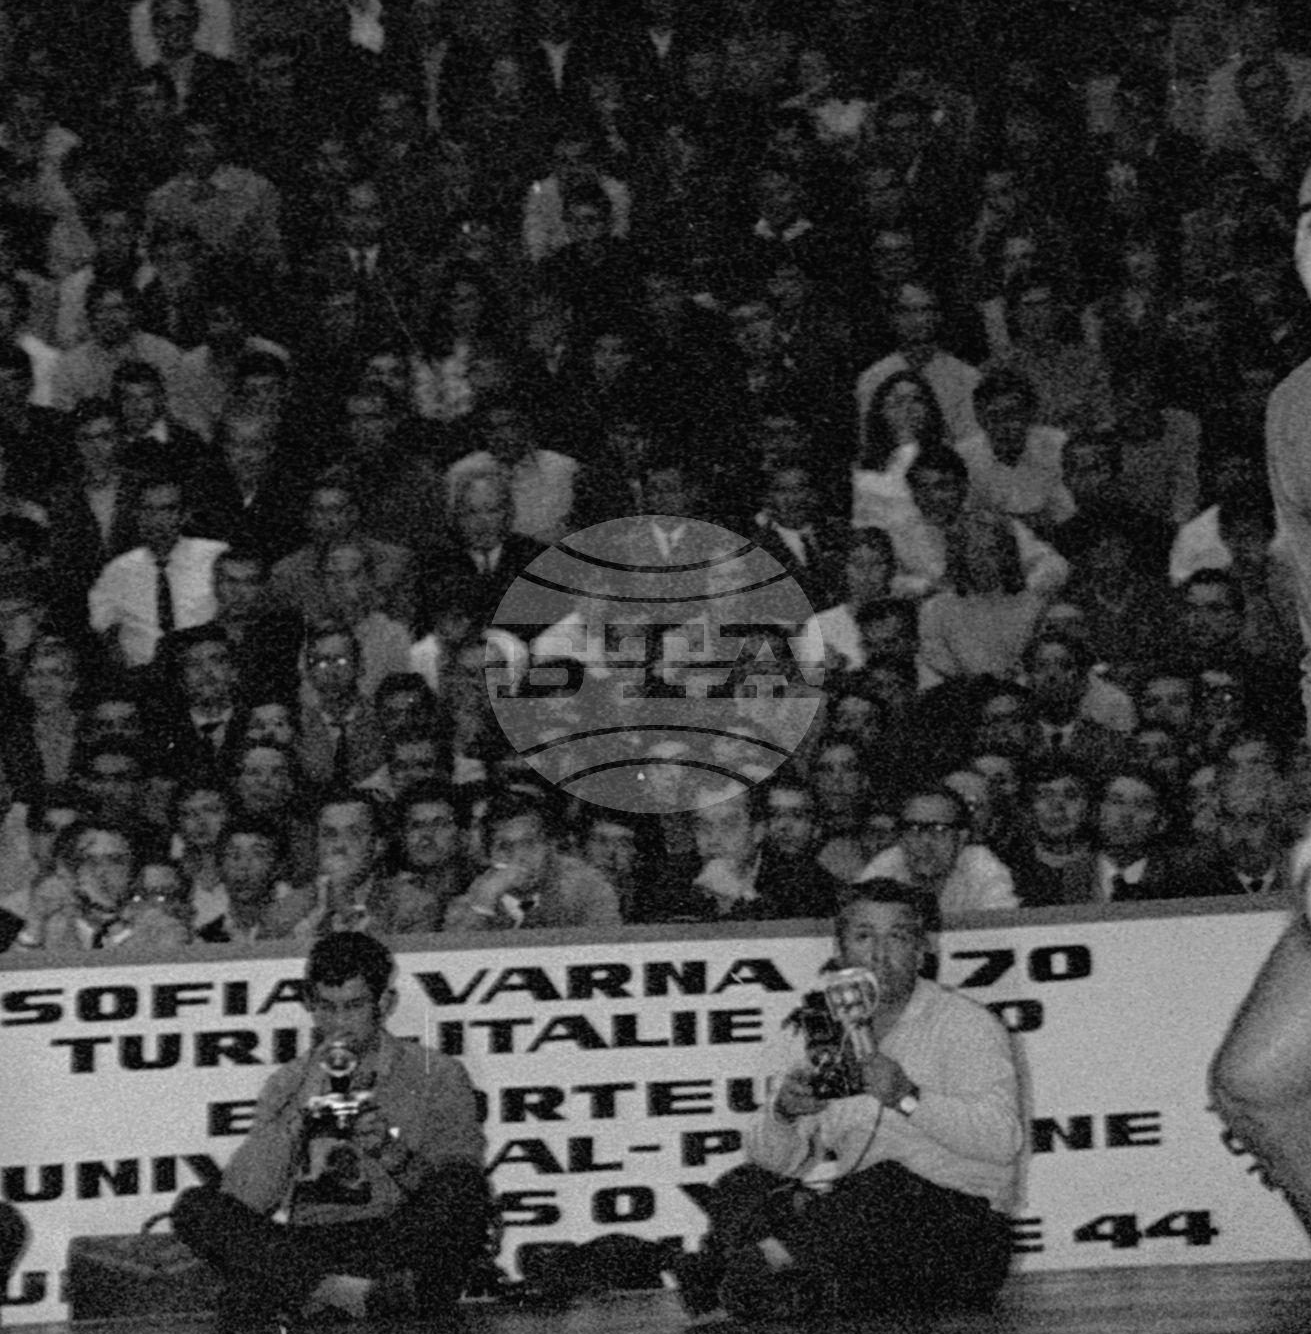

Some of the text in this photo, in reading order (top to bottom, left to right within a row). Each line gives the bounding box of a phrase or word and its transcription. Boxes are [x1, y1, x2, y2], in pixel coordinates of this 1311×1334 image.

[0, 979, 318, 1027] SOFIA
[412, 958, 794, 1007] VARNA
[50, 1008, 763, 1074] TURI ITALIE
[1073, 1210, 1220, 1249] 44
